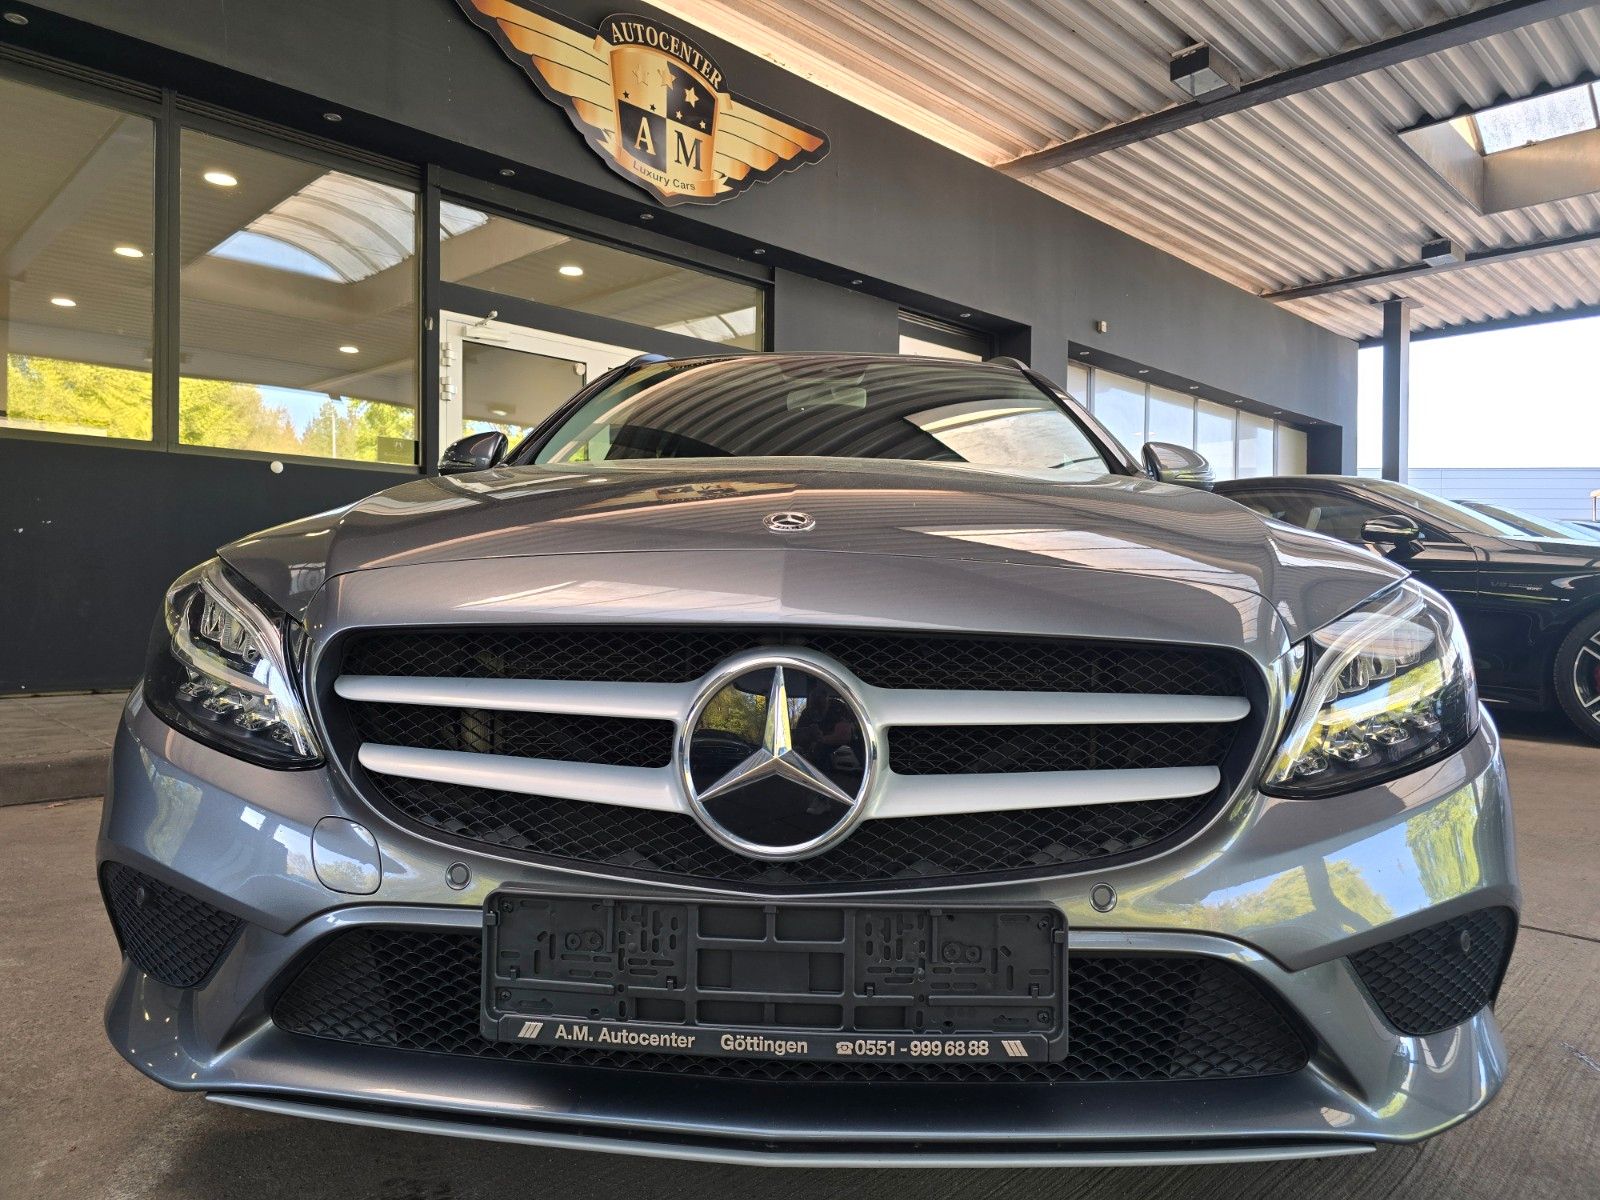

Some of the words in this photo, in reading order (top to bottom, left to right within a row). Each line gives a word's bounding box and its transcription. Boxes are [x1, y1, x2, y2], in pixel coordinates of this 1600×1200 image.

[611, 22, 722, 90] AUTOCENTER
[634, 116, 656, 156] A
[674, 130, 703, 172] M
[633, 160, 670, 187] Luxury
[672, 178, 696, 191] Cars
[555, 1024, 593, 1042] A.M.
[598, 1027, 695, 1048] Autocenter
[720, 1034, 808, 1056] Göttingen
[854, 1040, 896, 1056] 0551
